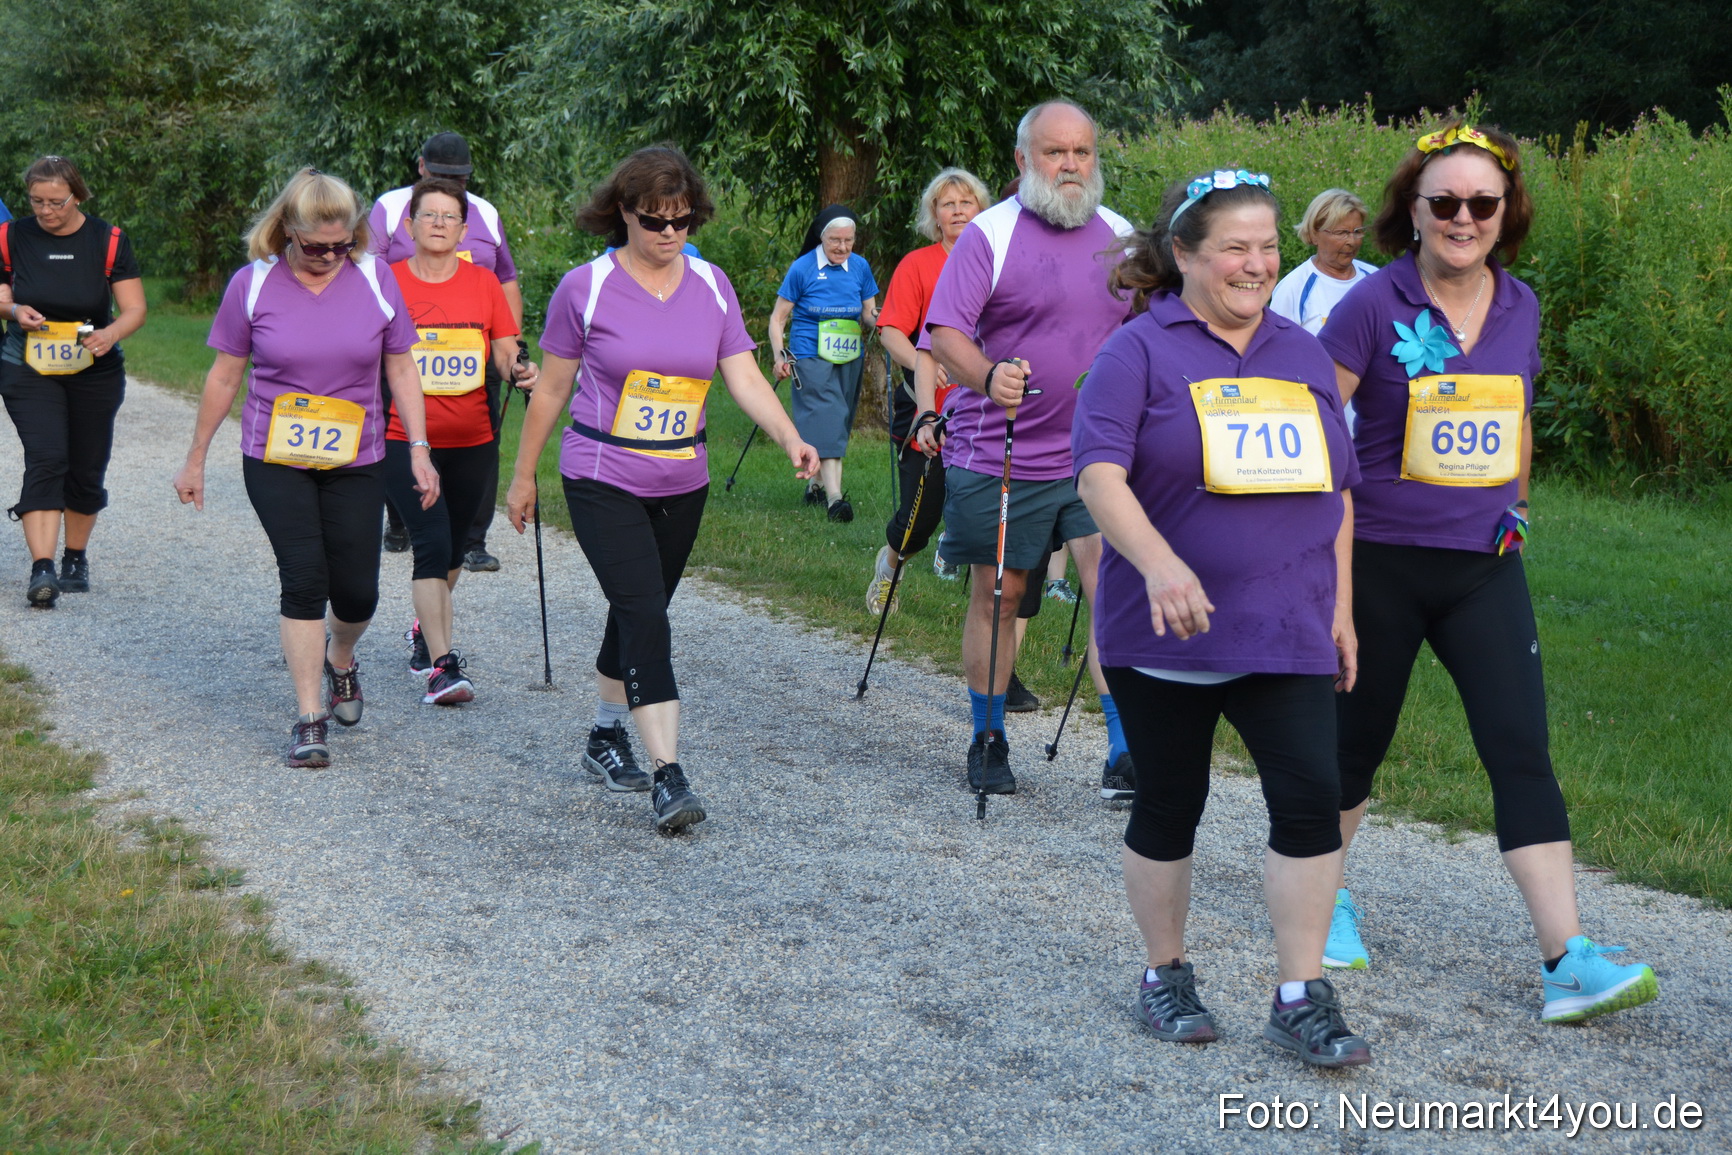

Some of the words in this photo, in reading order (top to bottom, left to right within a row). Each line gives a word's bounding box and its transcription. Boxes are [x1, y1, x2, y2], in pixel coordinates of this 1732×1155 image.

[824, 336, 858, 353] 1444
[33, 343, 84, 360] 1187
[416, 355, 478, 377] 1099
[628, 392, 654, 402] walken
[1215, 395, 1257, 405] firmenlauf
[1429, 393, 1471, 402] firmenlauf
[1205, 408, 1240, 417] walken
[1416, 405, 1450, 414] walken
[634, 406, 687, 436] 318
[287, 423, 342, 451] 312
[1226, 422, 1302, 459] 710
[1431, 420, 1501, 455] 696
[1257, 467, 1302, 475] Koltzenburg
[1438, 463, 1464, 471] Regina
[1465, 463, 1490, 471] Pflüger
